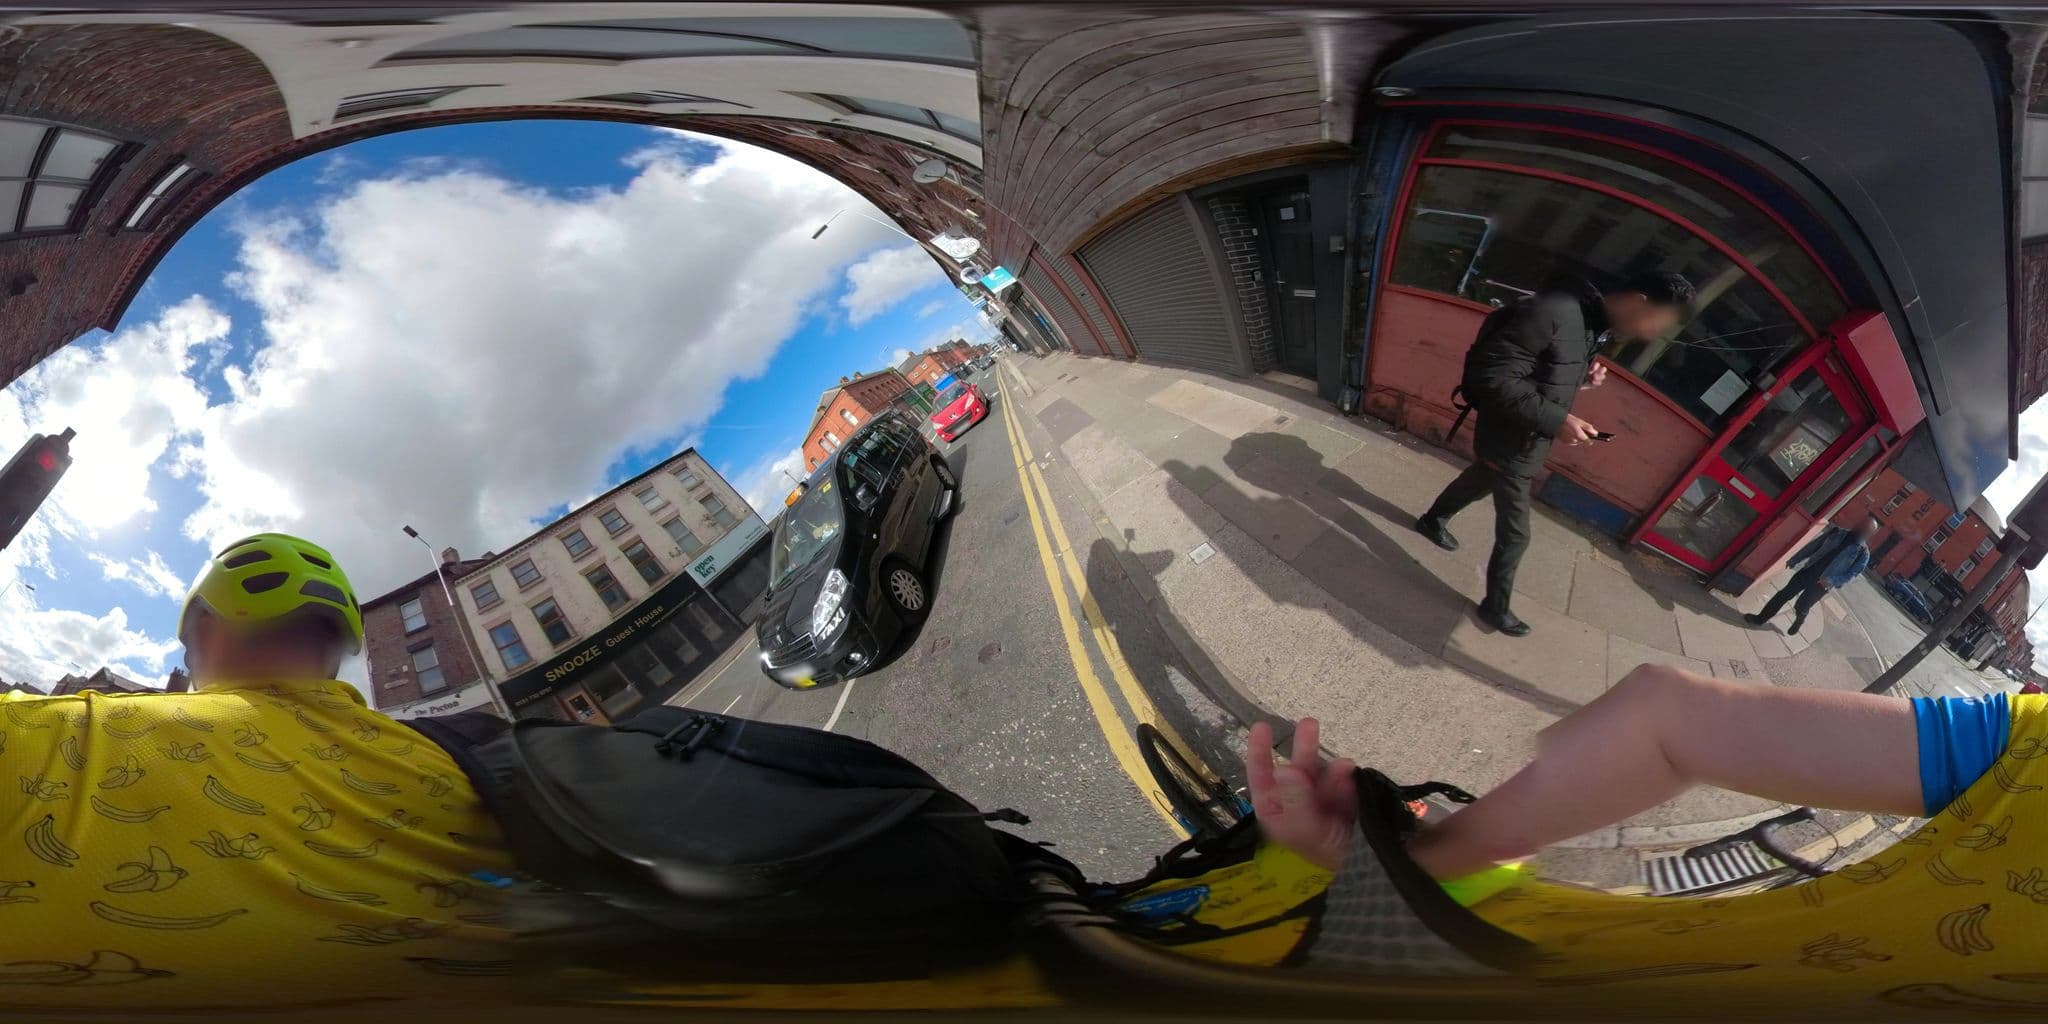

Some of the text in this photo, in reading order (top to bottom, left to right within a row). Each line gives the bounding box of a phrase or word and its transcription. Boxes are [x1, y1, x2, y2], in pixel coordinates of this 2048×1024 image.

[694, 555, 715, 573] open
[699, 562, 716, 578] key
[820, 606, 846, 640] TAXI
[545, 644, 602, 682] SNOOZE
[605, 624, 635, 648] Guest
[634, 605, 664, 628] House
[430, 700, 460, 714] Picton
